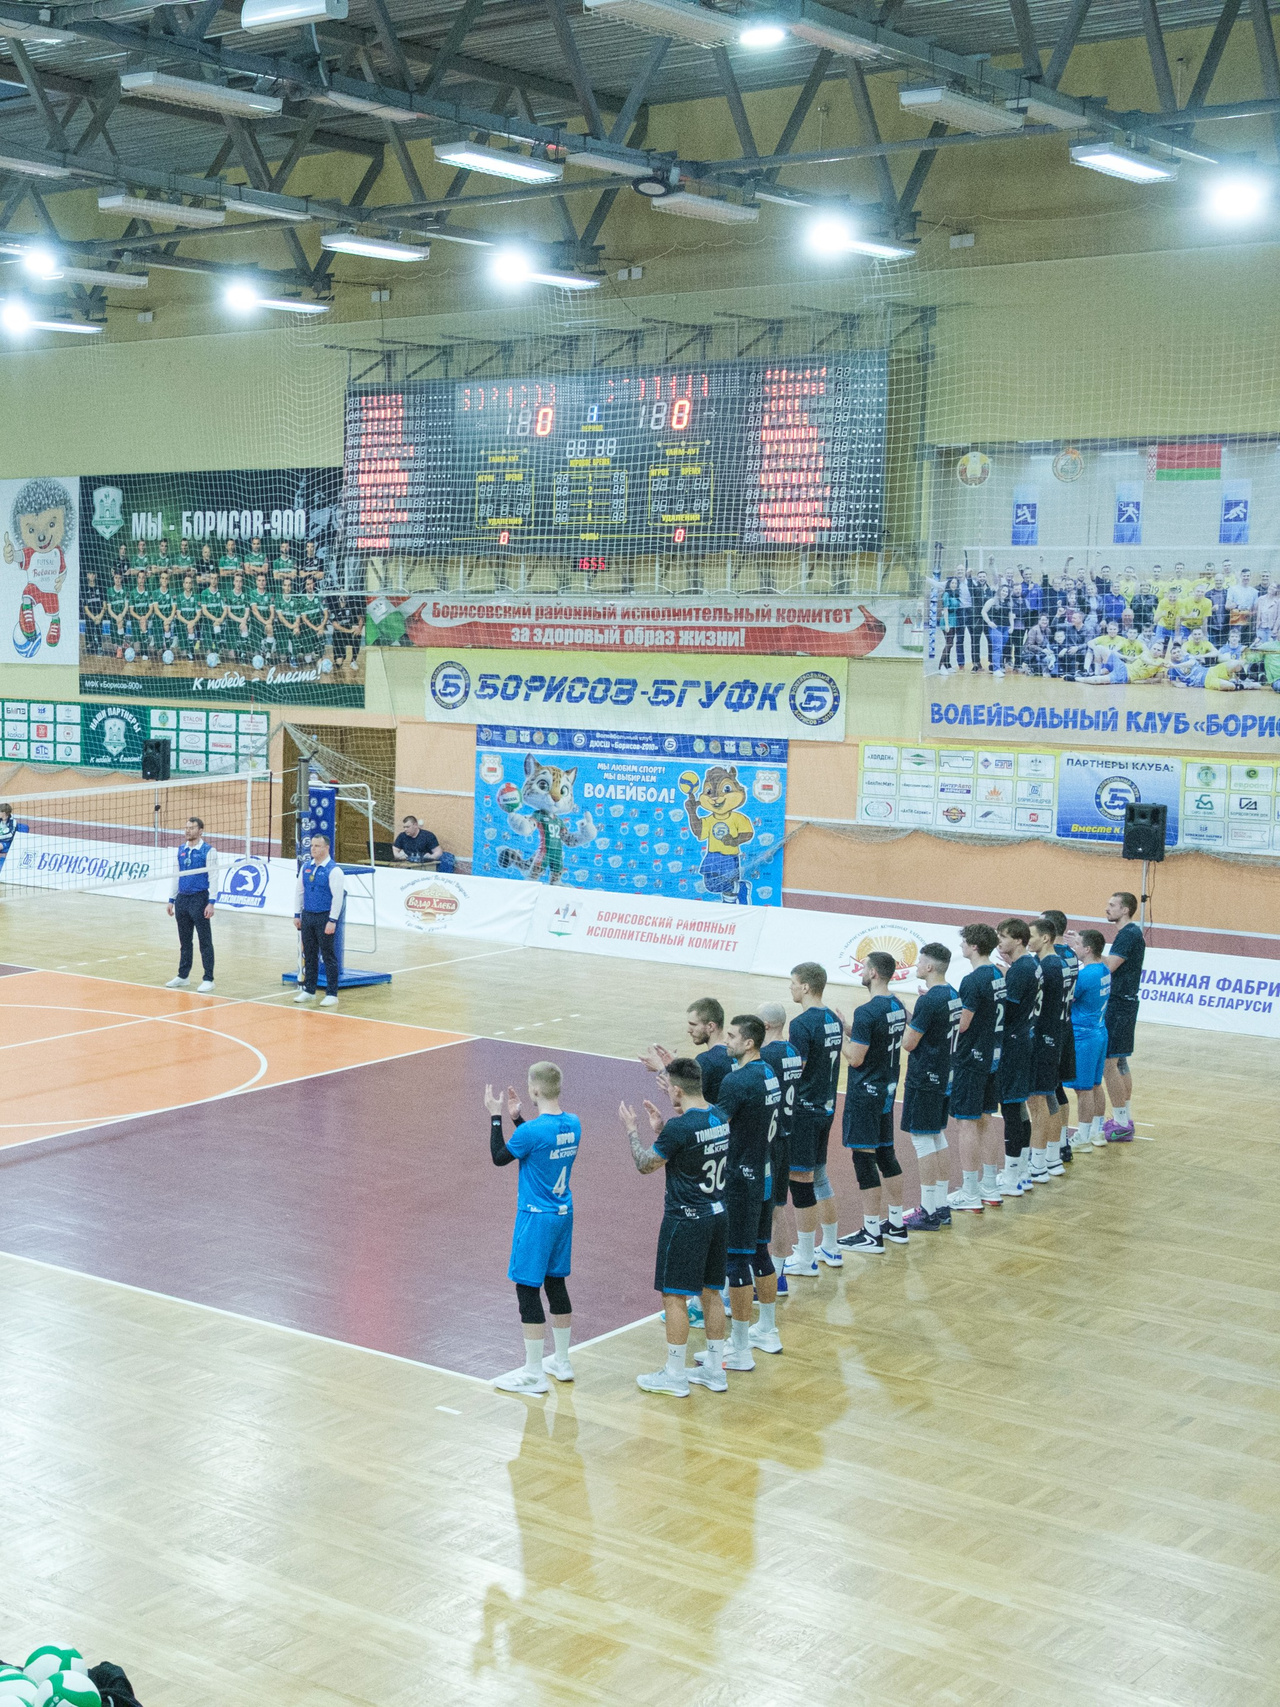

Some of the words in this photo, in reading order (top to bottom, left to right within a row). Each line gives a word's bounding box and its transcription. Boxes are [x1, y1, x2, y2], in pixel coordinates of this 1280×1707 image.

[536, 408, 553, 435] 0
[672, 400, 690, 429] 0
[131, 511, 163, 541] МЫ
[182, 509, 307, 541] БОРИСОВ-900
[675, 529, 685, 542] 0
[499, 532, 509, 545] 0
[432, 601, 532, 620] Борисовский
[535, 602, 617, 622] районный
[621, 603, 771, 623] исполнительный
[776, 607, 854, 624] комитет
[511, 627, 530, 642] за
[533, 624, 621, 646] здоровый
[623, 626, 675, 646] образ
[678, 627, 746, 648] жизни!
[85, 680, 99, 688] МФК
[207, 671, 247, 689] победе
[266, 666, 323, 686] вместе!
[474, 672, 786, 713] БОРИСОВ-БГУФК
[89, 709, 107, 730] НАШИ
[107, 707, 142, 734] ПАРТНЕРЫ
[931, 702, 1119, 732] ВОЛЕЙБОЛЬНЫЙ
[1126, 710, 1191, 734] КЛУБ
[589, 740, 611, 748] ДЮСШ
[596, 732, 638, 740] Волейбольный
[597, 763, 610, 771] МЫ
[611, 764, 638, 773] ЛЮБИМ
[639, 766, 666, 774] СПОРТ!
[603, 772, 616, 780] МЫ
[617, 773, 657, 782] ВЫБИРАЕМ
[1066, 758, 1129, 770] ПАРТНЕРЫ
[1132, 762, 1175, 773] КЛУБА:
[583, 782, 676, 804] ВОЛЕЙБОЛ!
[548, 824, 562, 839] 92
[1071, 823, 1113, 834] Вместе
[37, 851, 150, 882] БОРИСОВДРЕВ
[596, 910, 673, 929] БОРИСОВСКИЙ
[676, 918, 737, 936] РАЙОННЫЙ
[586, 926, 685, 947] ИСПОЛНИТЕЛЬНЫЙ
[688, 937, 739, 952] КОМИТЕТ
[1199, 996, 1273, 1013] БЕЛАРУСИ
[552, 1166, 567, 1197] 4
